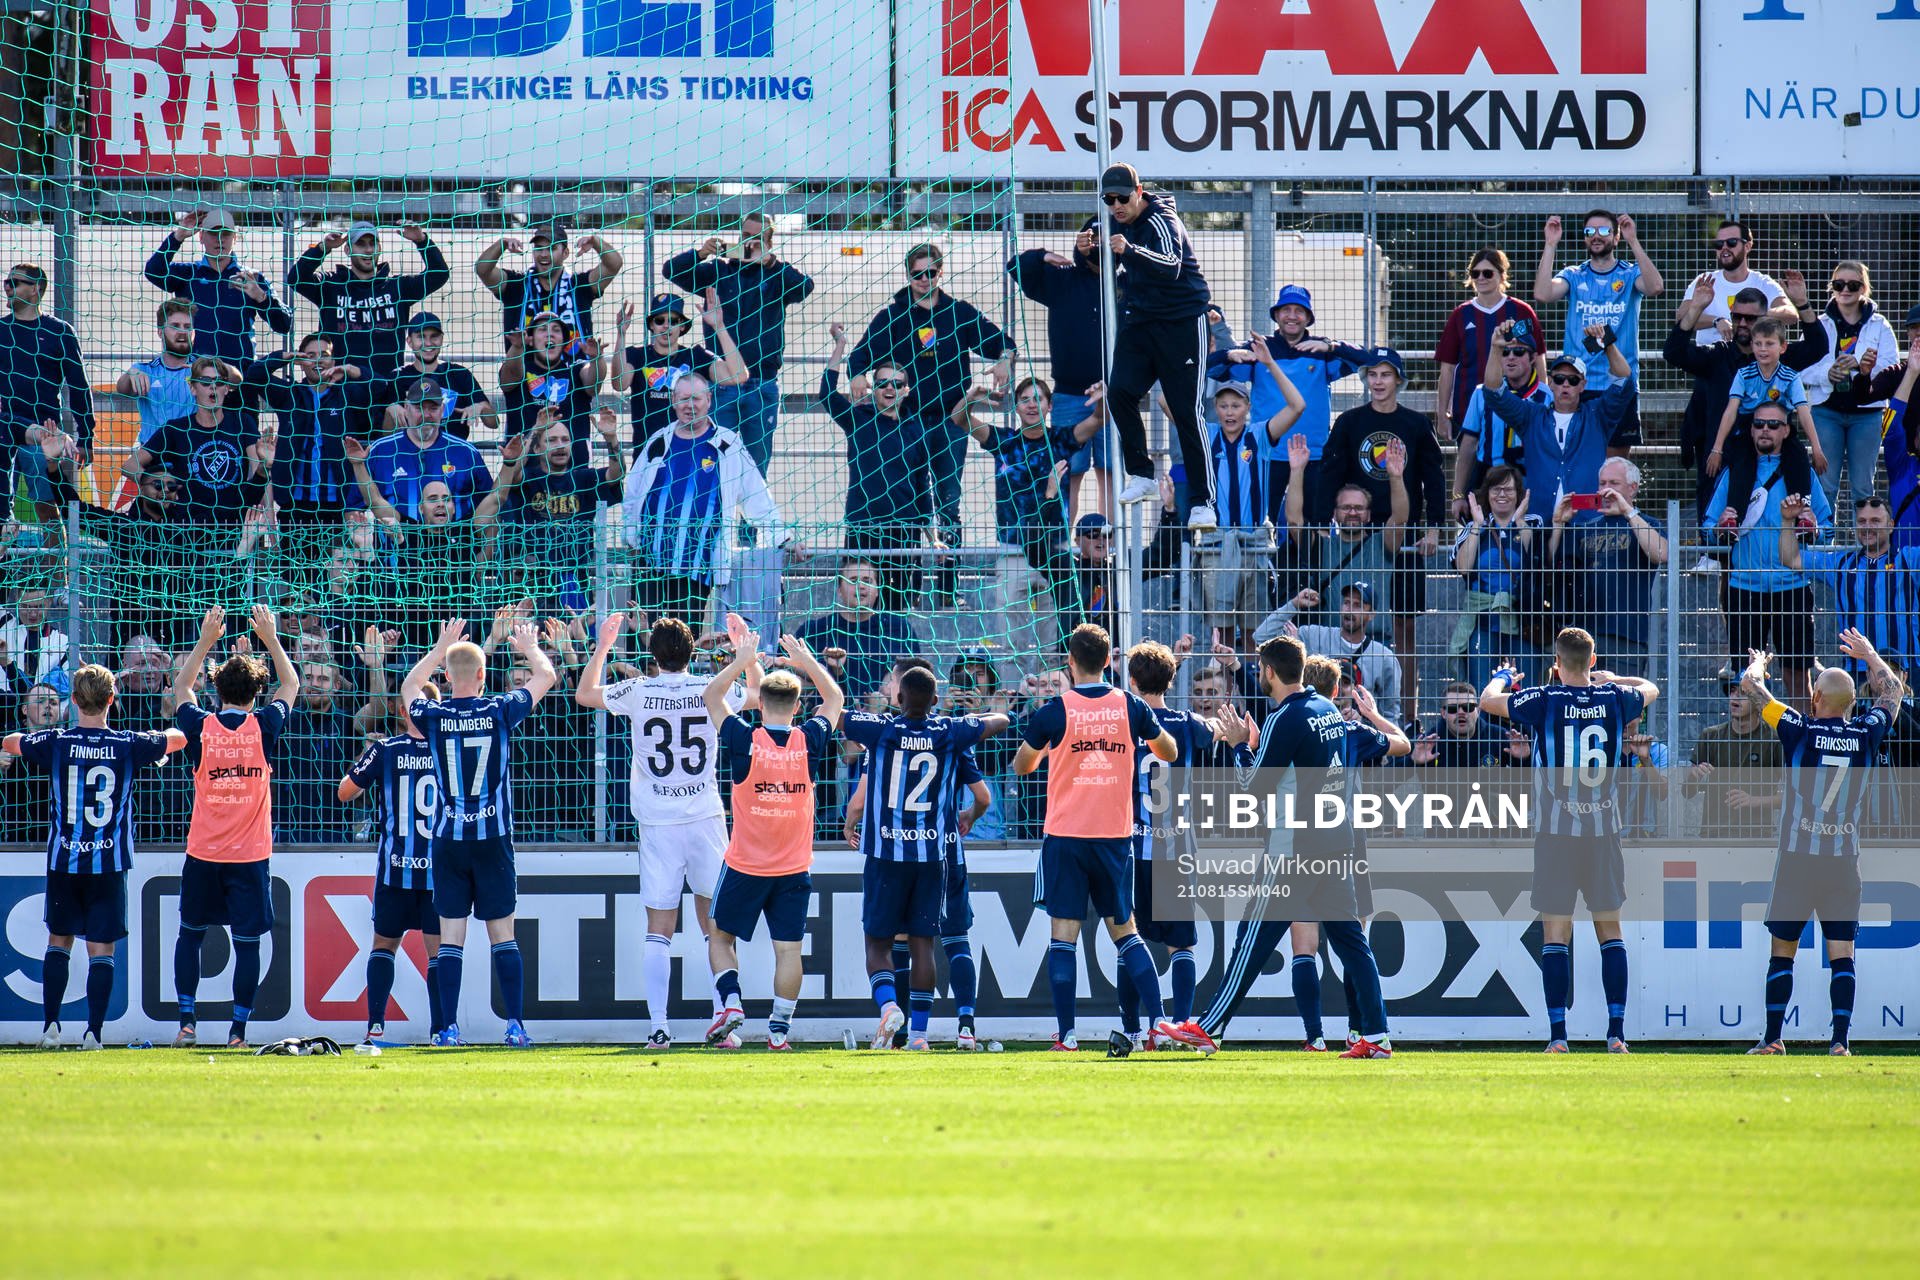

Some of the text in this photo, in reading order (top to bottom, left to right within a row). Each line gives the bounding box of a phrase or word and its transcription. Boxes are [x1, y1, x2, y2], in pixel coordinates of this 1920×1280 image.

[408, 71, 814, 100] BLEKINGE LÄNS TIDNING
[105, 58, 320, 155] RAN
[1746, 81, 1920, 119] NÄR DU
[942, 88, 1646, 152] ICA STORMARKNAD
[337, 306, 395, 323] DENIM
[1576, 301, 1625, 314] Prioritet
[1068, 706, 1126, 724] Prioritet
[1564, 704, 1607, 719] LÖFGREN
[441, 717, 493, 732] HOLMBERG
[1074, 722, 1118, 736] Finans
[206, 744, 254, 758] Finans
[643, 716, 707, 777] 35
[900, 736, 933, 750] BANDA
[1071, 738, 1126, 754] stadium
[1815, 735, 1860, 752] ERIKSSON
[70, 744, 117, 759] FINNDELL
[1563, 725, 1608, 787] 16
[209, 764, 262, 780] stadium
[446, 736, 492, 797] 17
[1079, 762, 1112, 770] adidas
[212, 782, 247, 790] adidas
[754, 781, 806, 793] stadium
[887, 751, 938, 812] 12
[1072, 775, 1118, 785] stadium
[1140, 752, 1169, 814] 3
[1820, 755, 1851, 813] 7
[67, 765, 116, 828] 13
[207, 794, 253, 804] stadium
[399, 774, 438, 840] 19
[750, 806, 796, 817] stadium
[401, 857, 432, 869] FXO
[1665, 1005, 1904, 1027] HUMN
